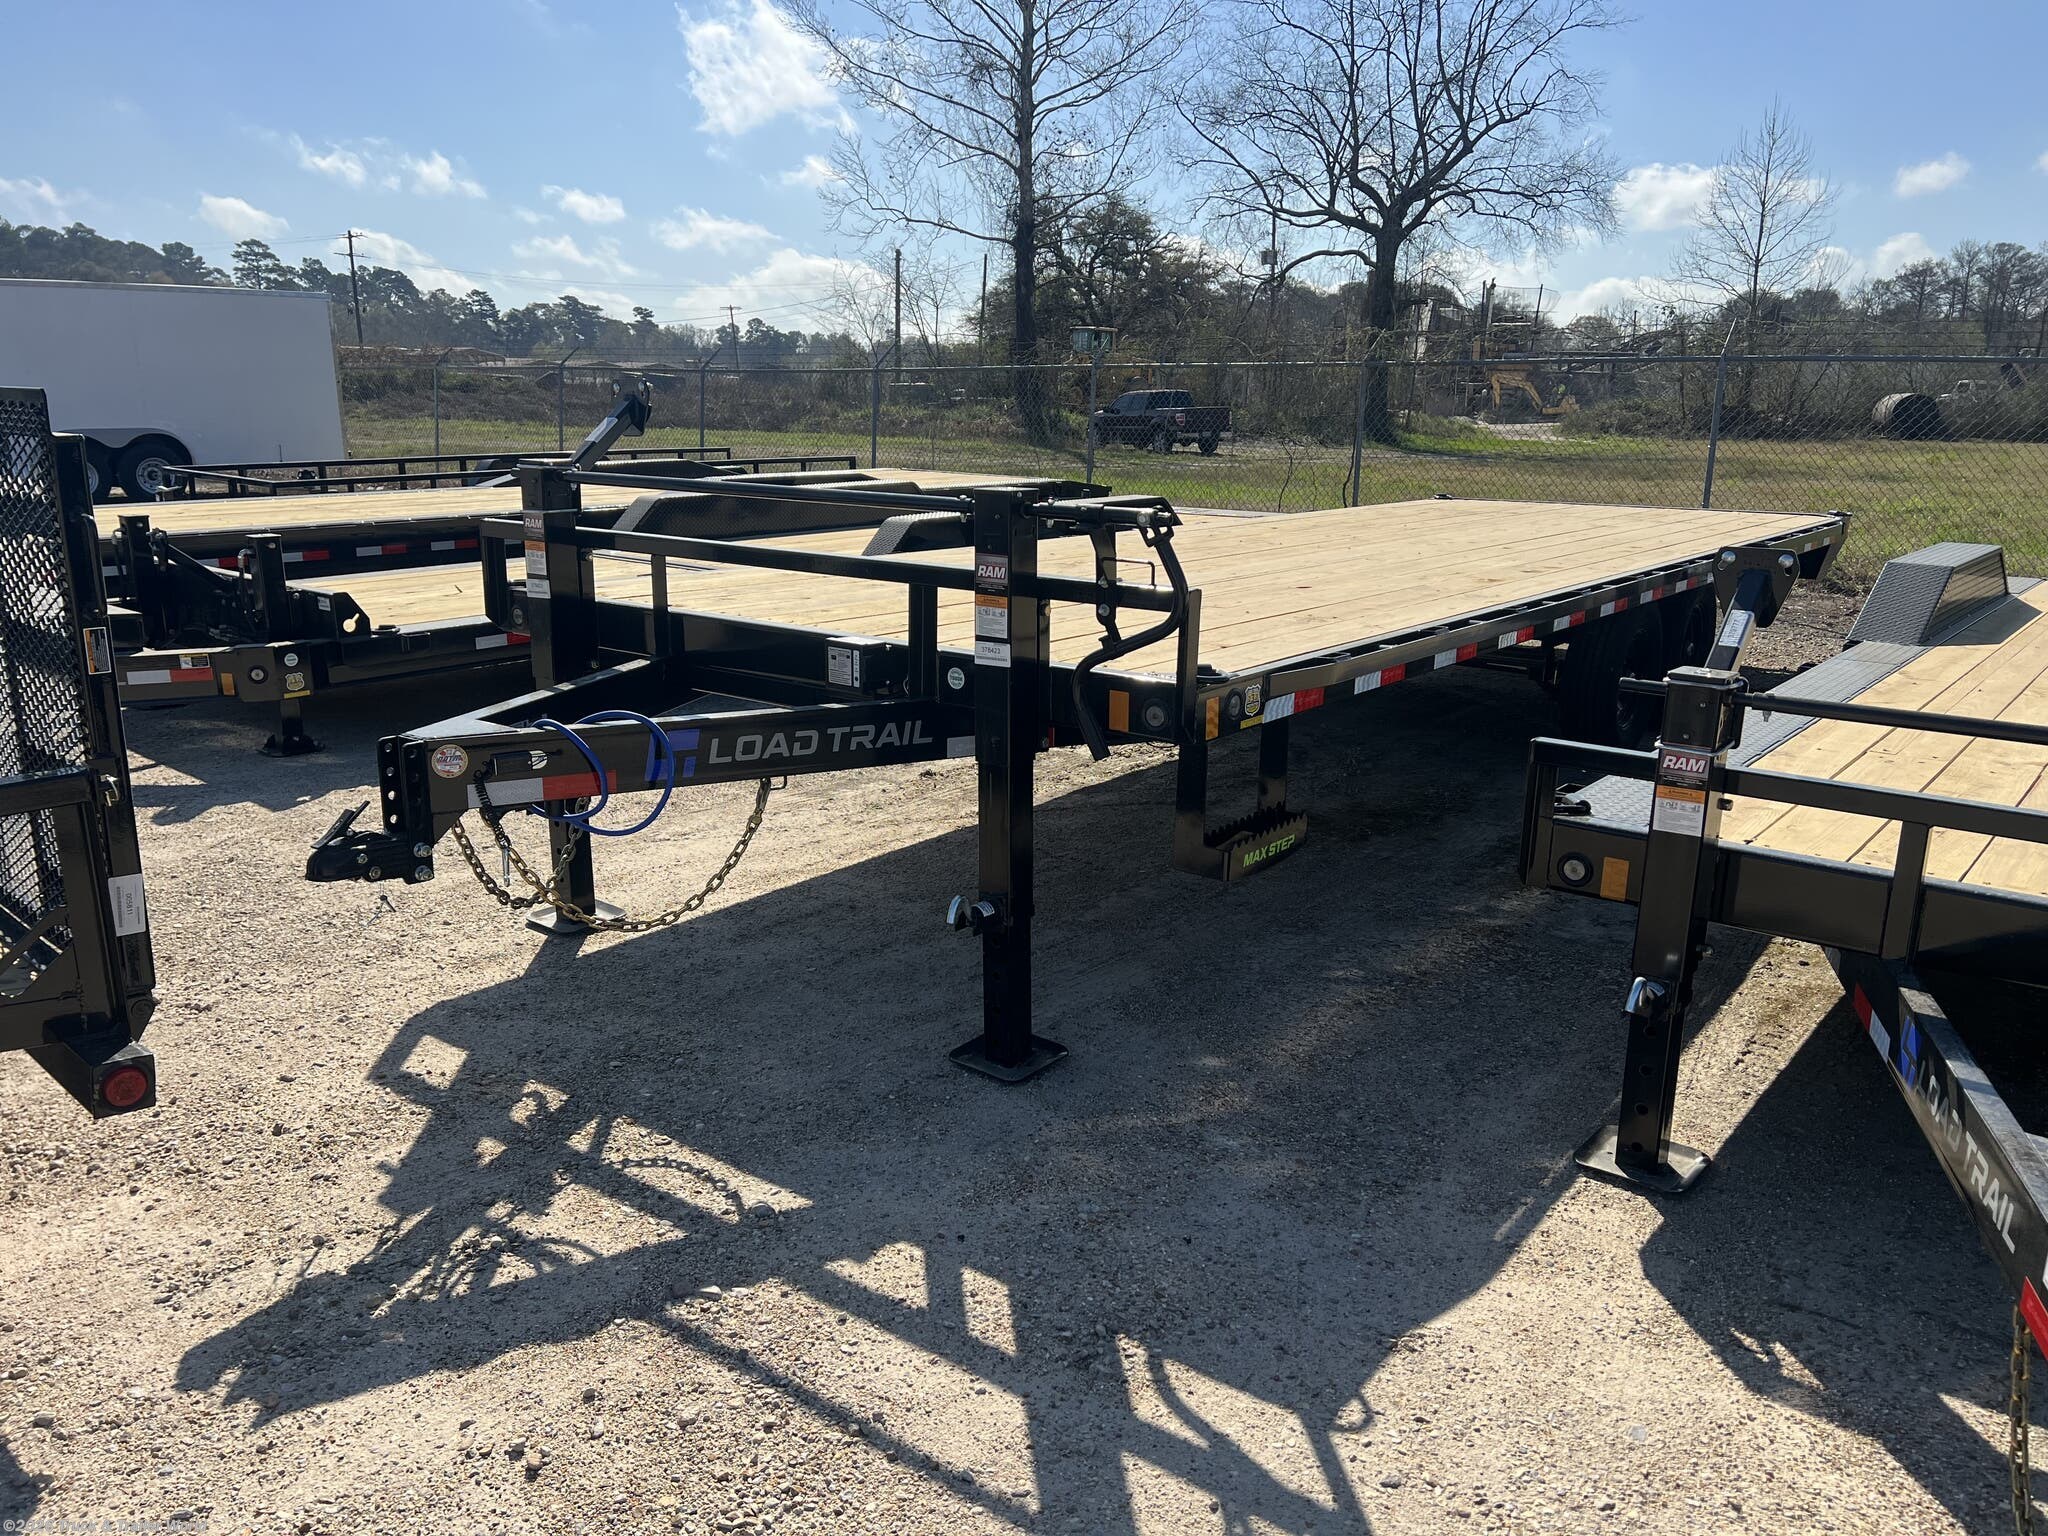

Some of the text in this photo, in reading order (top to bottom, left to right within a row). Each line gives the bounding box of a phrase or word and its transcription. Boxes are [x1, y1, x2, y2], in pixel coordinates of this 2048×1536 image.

[524, 518, 543, 529] RAM
[977, 564, 1006, 579] RAM
[708, 720, 933, 765] LOAD TRAIL
[1662, 755, 1707, 773] RAM
[1242, 833, 1296, 868] MAX STEP
[1914, 1059, 2016, 1255] LOAD TRAIL
